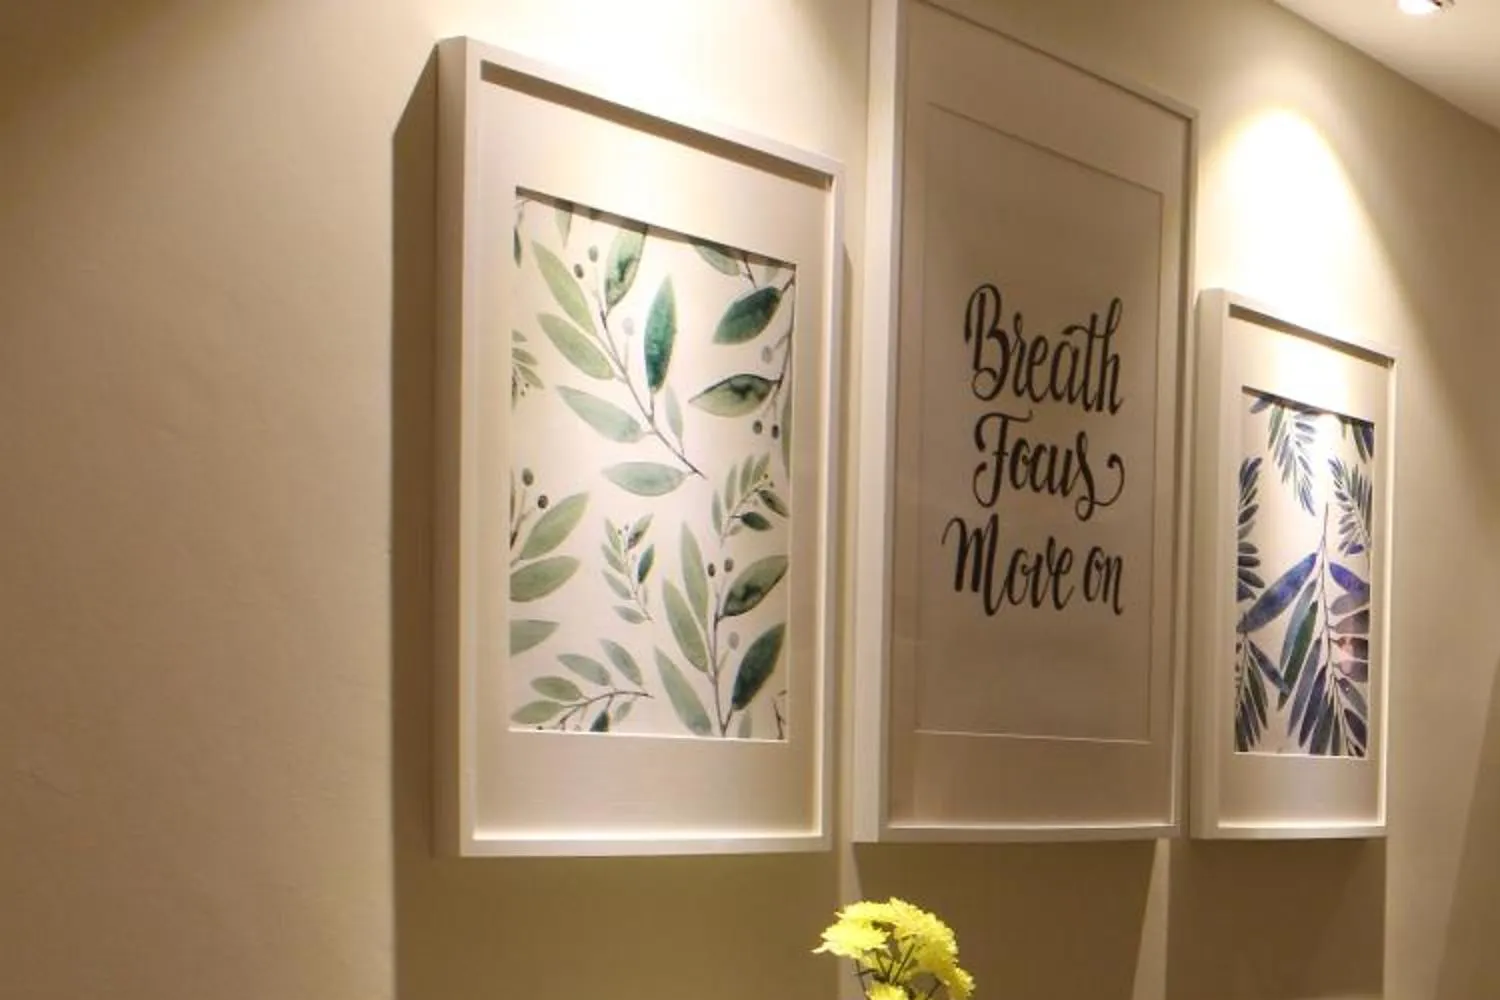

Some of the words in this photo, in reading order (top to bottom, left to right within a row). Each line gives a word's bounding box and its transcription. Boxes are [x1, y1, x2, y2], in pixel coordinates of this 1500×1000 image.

[964, 283, 1124, 415] Breath
[973, 410, 1125, 521] Focus
[941, 514, 1075, 616] Move
[1084, 545, 1124, 616] on
